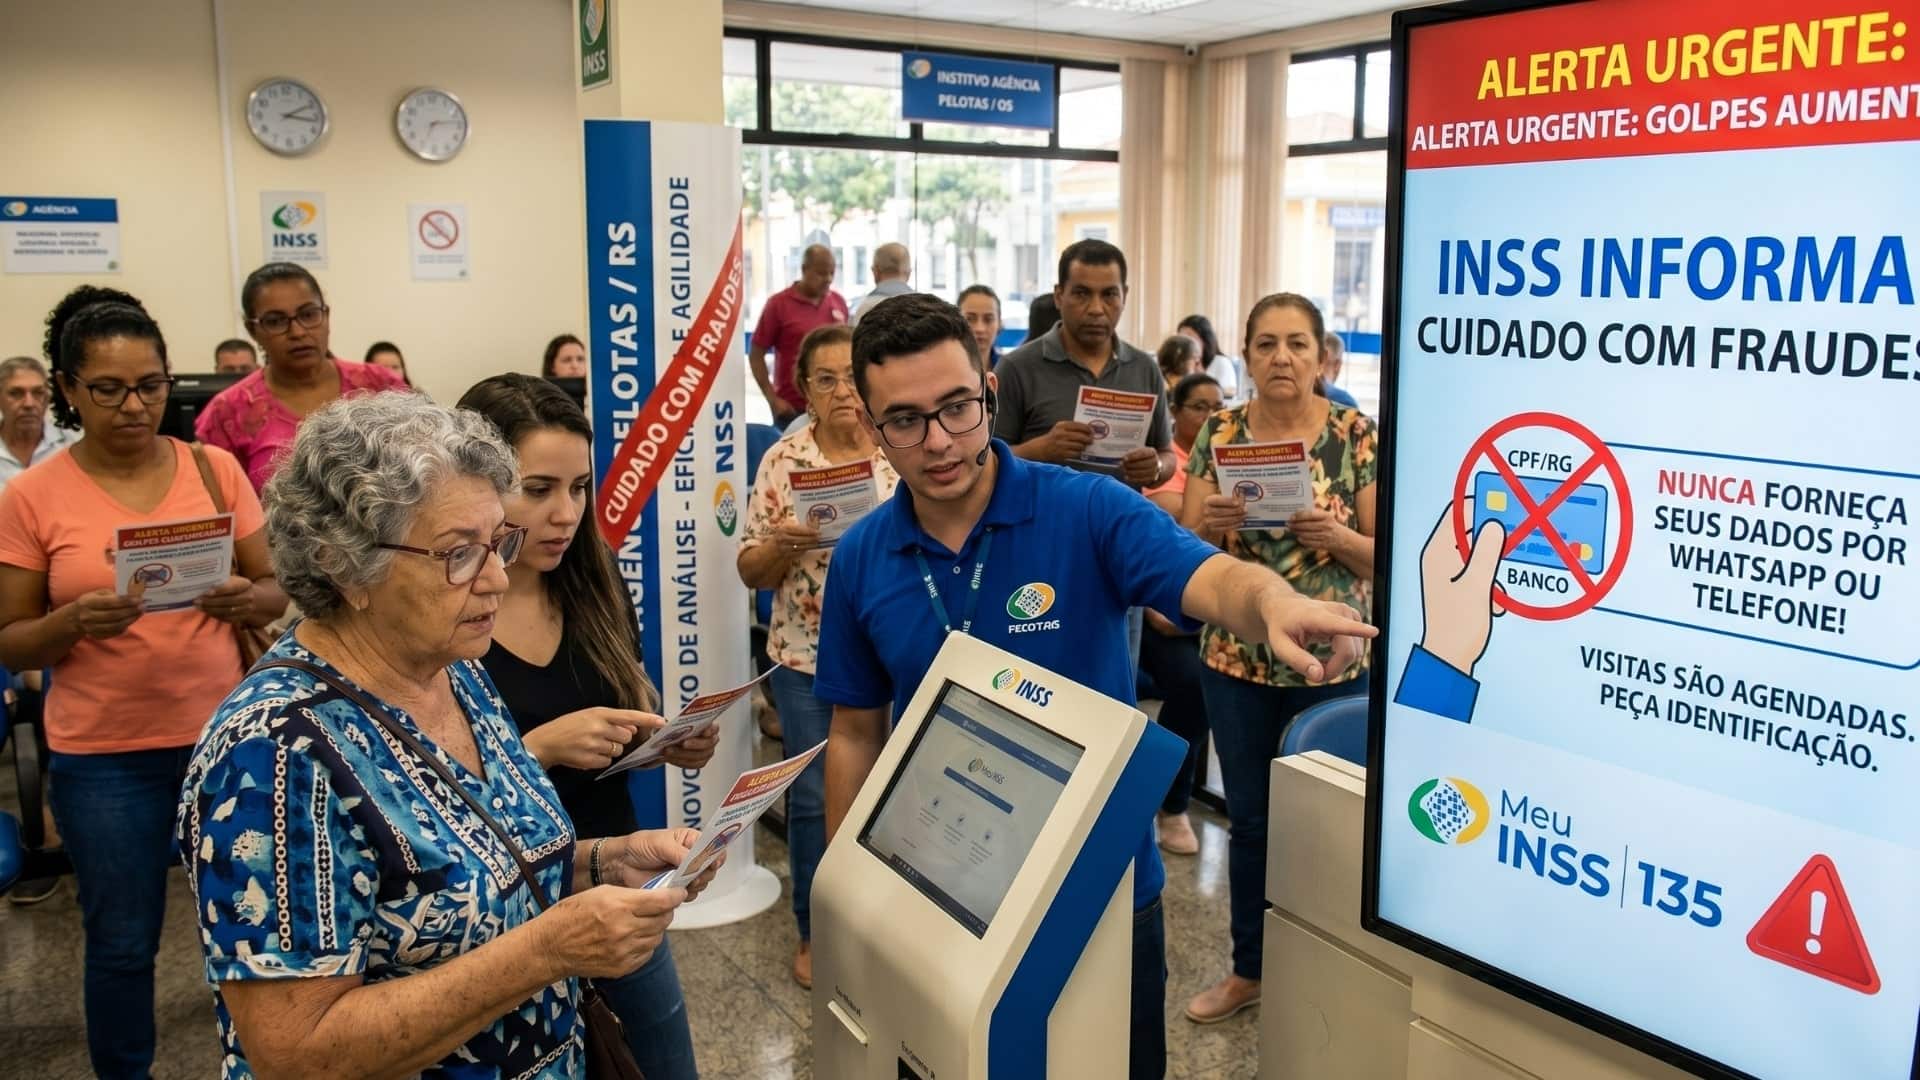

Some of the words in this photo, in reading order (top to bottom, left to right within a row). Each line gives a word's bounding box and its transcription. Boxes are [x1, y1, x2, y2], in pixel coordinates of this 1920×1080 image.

[584, 49, 606, 77] INSS
[991, 74, 1041, 92] AGÊNCIA
[1477, 42, 1632, 101] ALERTA
[1645, 11, 1907, 83] URGENTE:
[938, 94, 989, 110] PELOTAS
[1411, 119, 1500, 151] ALERTA
[1505, 107, 1639, 145] URGENTE:
[1645, 96, 1767, 135] GOLPES
[273, 233, 318, 248] INSS
[608, 221, 636, 266] RS
[669, 176, 691, 319] AGILIDADE
[608, 277, 638, 294] /
[1438, 237, 1562, 297] INSS
[1580, 236, 1915, 304] INFORMA
[1417, 316, 1587, 361] CUIDADO
[1598, 322, 1696, 367] COM
[1711, 327, 1920, 380] FRAUDE
[605, 422, 669, 524] CUIDADO
[661, 364, 704, 422] COM
[694, 256, 743, 366] FRAUDES
[1507, 449, 1573, 473] CPF/RG
[1657, 469, 1756, 506] NUNCA
[1764, 482, 1908, 529] FORNEÇA
[1654, 505, 1721, 536] SEUS
[1729, 514, 1833, 554] DADOS
[1841, 534, 1907, 566] POR
[672, 519, 698, 626] ANÁLISE
[1507, 567, 1569, 594] BANCO
[1669, 543, 1827, 592] WHATSAPP
[1834, 570, 1881, 600] OU
[1693, 582, 1847, 635] TELEFONE!
[679, 634, 698, 665] DE
[1016, 679, 1053, 707] INSS
[1579, 645, 1666, 685] VISITAS
[1674, 664, 1724, 697] SÃO
[1731, 679, 1915, 742] AGENDADAS.
[1600, 683, 1660, 720] PEÇA
[1667, 699, 1879, 772] IDENTIFICAÇÃO.
[1501, 789, 1572, 838] Meu
[1498, 825, 1610, 898] INSS
[1638, 860, 1723, 928] 135
